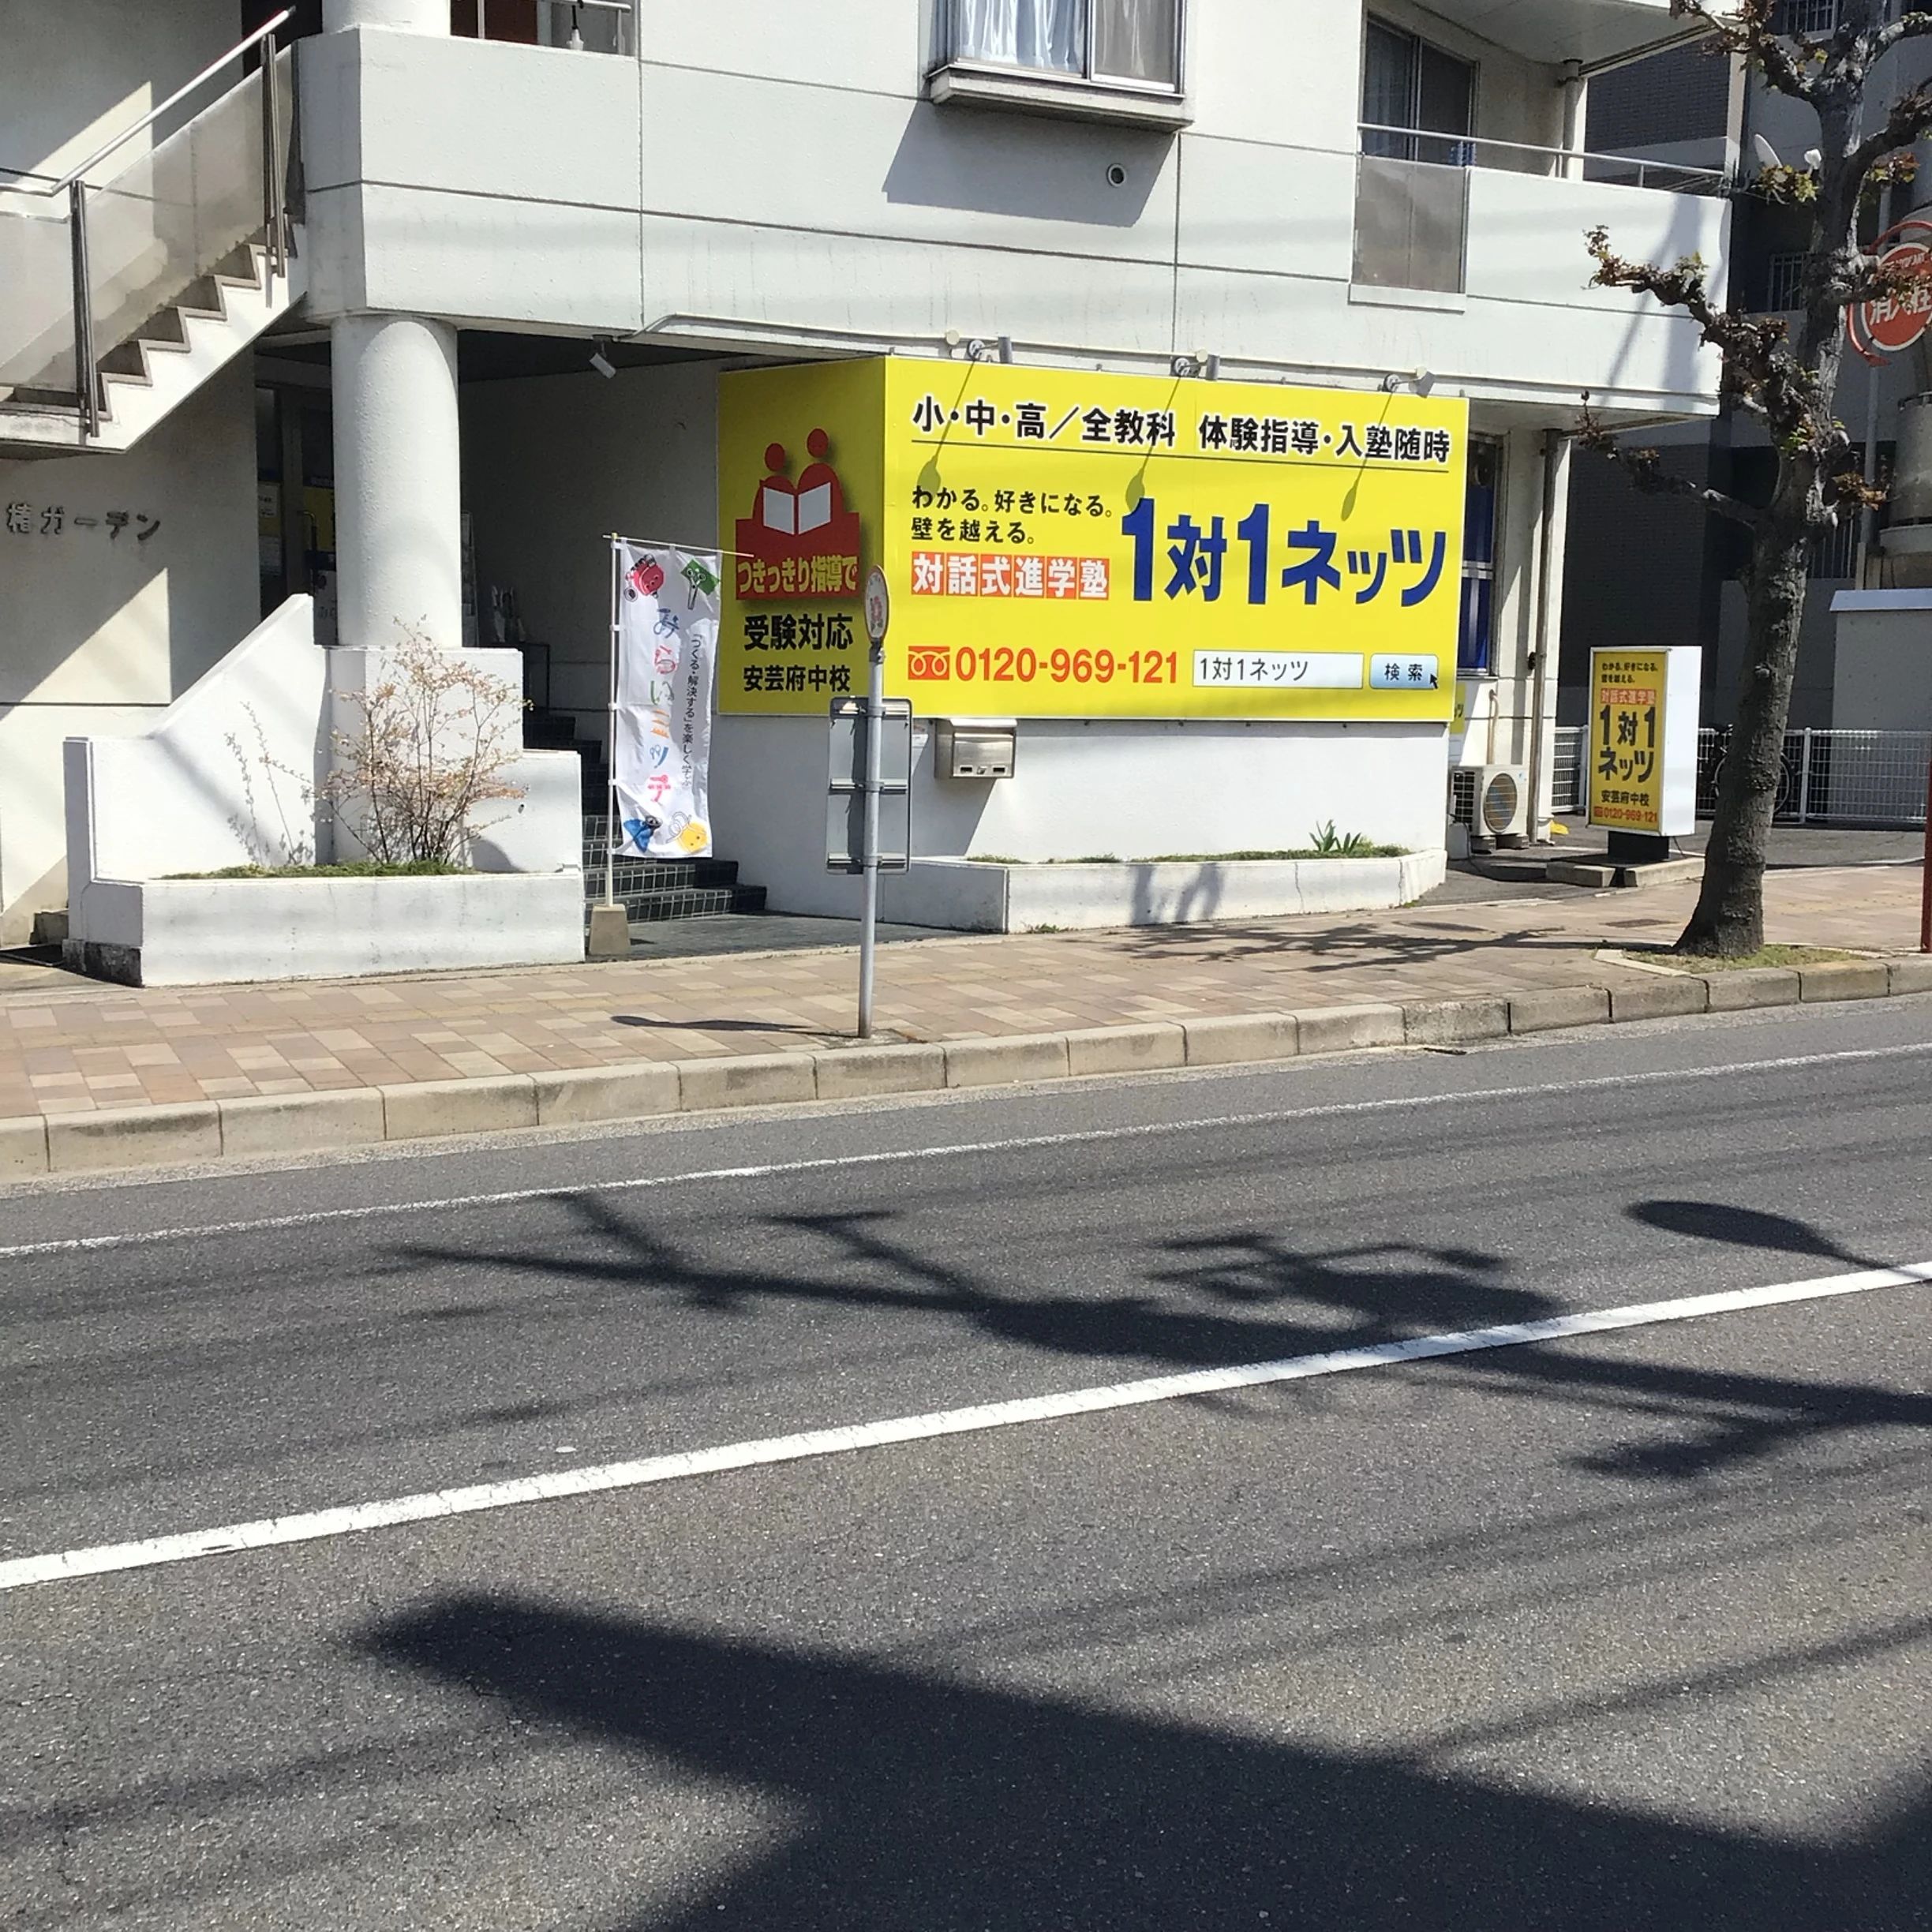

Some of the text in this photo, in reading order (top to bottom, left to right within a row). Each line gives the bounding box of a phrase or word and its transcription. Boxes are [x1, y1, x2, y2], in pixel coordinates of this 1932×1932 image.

[1199, 414, 1450, 463] 体験指導・入塾随時
[912, 485, 1112, 518] わかる。好きになる。
[911, 517, 1035, 545] 壁を越える。
[1121, 497, 1447, 607] 1対1ネッツ
[737, 554, 858, 595] つきっきり指導で
[912, 554, 1108, 599] 対話式進学塾
[743, 613, 854, 651] 受験対応
[743, 664, 851, 692] 安芸府中校
[956, 646, 1178, 684] 0120-969-121
[1200, 657, 1309, 682] 1対1ネッツ
[1384, 663, 1424, 682] 検索
[1600, 705, 1657, 747] 1対1
[1598, 747, 1654, 784] ネッツ
[1601, 790, 1649, 807] 安芸府中校
